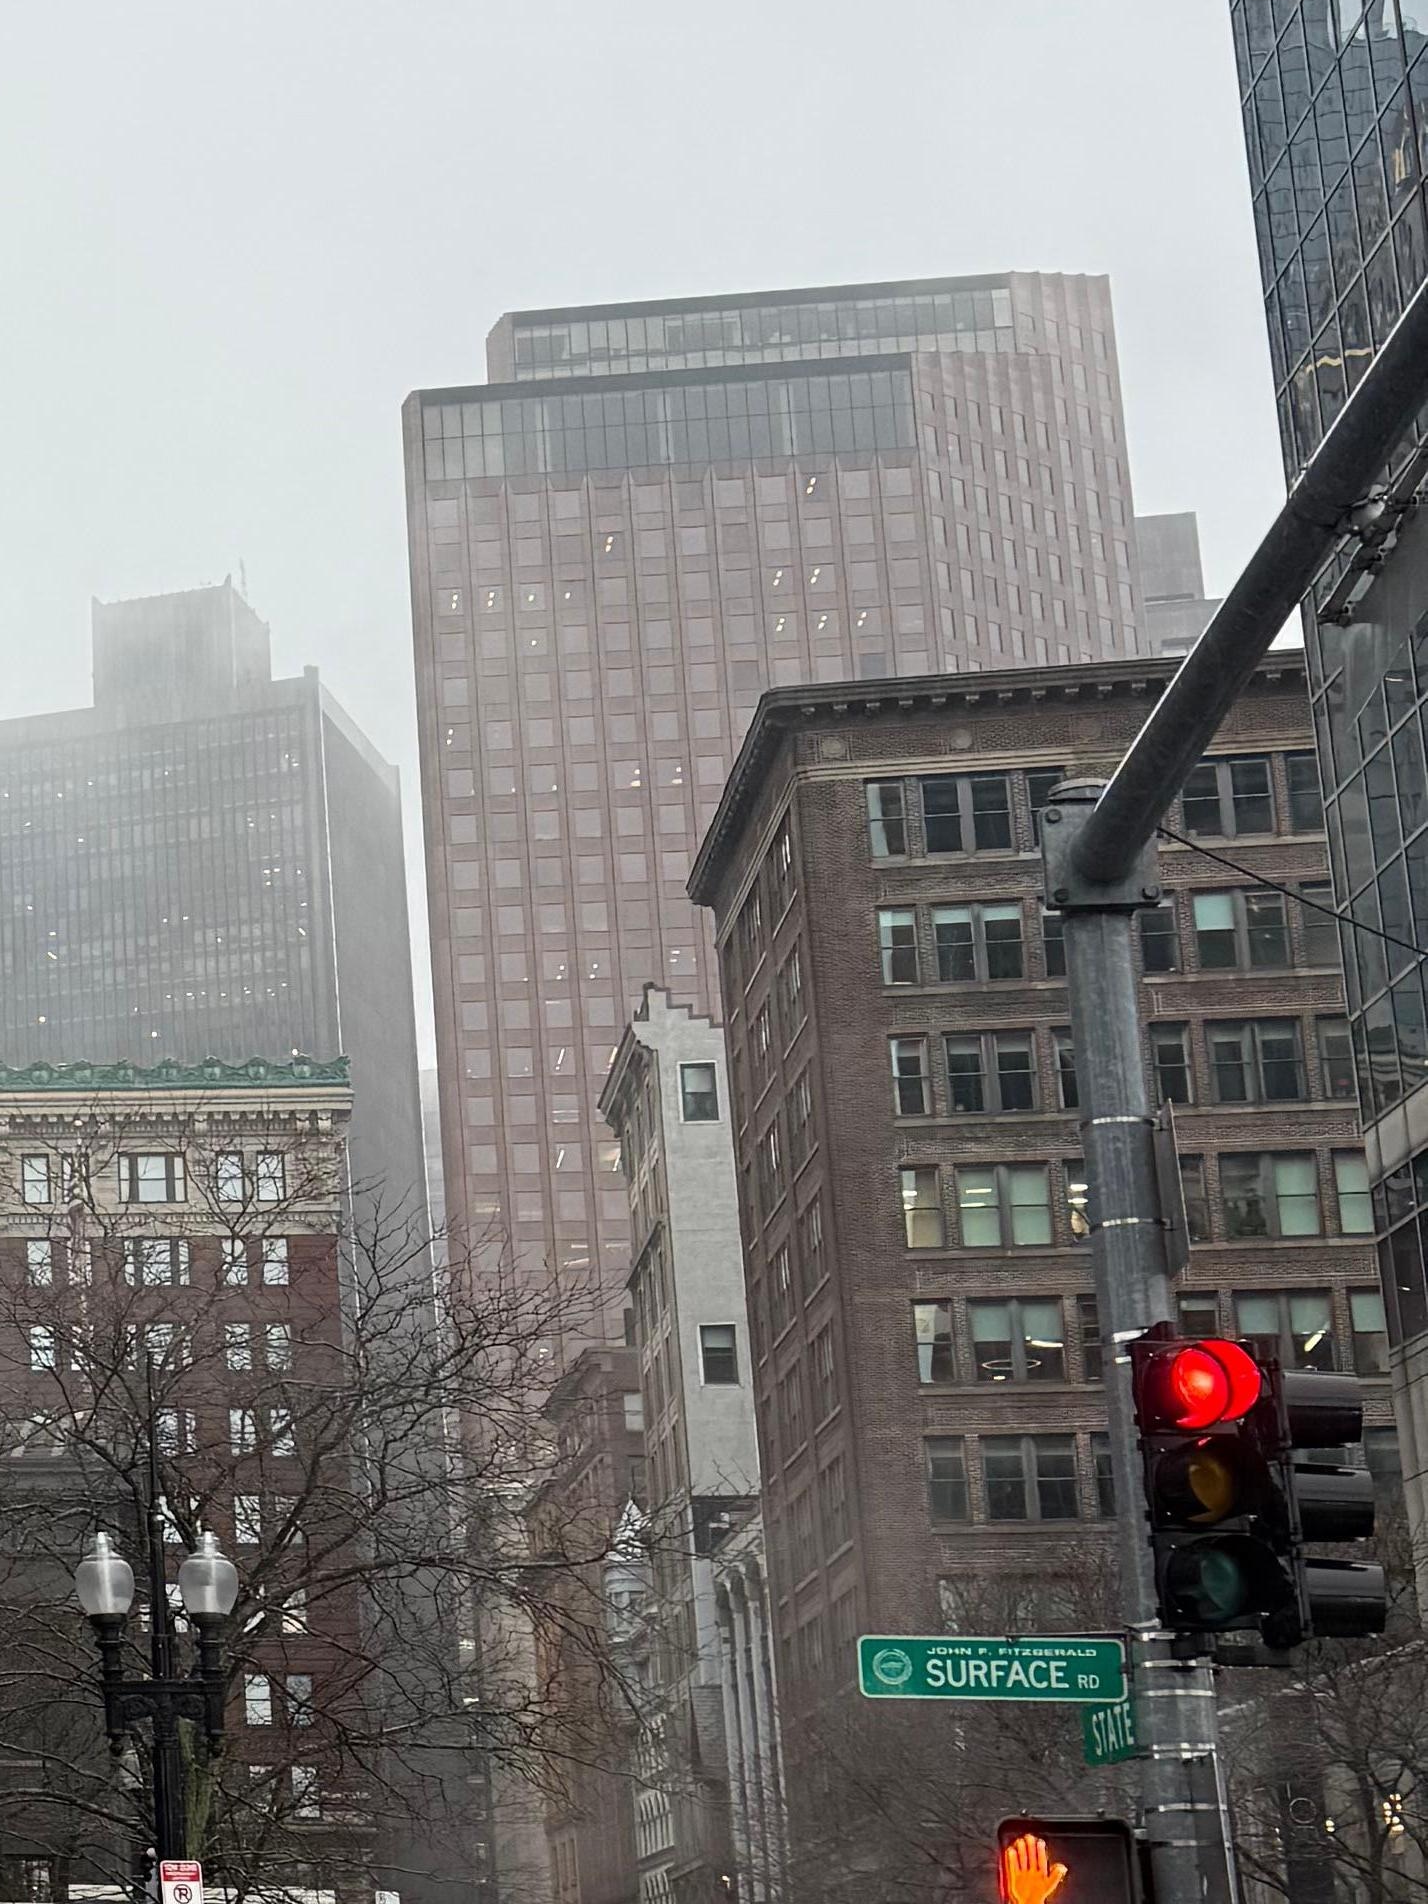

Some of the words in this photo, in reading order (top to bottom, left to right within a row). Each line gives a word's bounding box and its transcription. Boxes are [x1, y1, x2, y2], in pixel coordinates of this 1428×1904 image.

[927, 1647, 972, 1656] JOHN
[998, 1647, 1097, 1657] FITZGERALD
[926, 1659, 1069, 1689] SURFACE
[1078, 1675, 1100, 1689] RD
[1092, 1703, 1134, 1756] STATE
